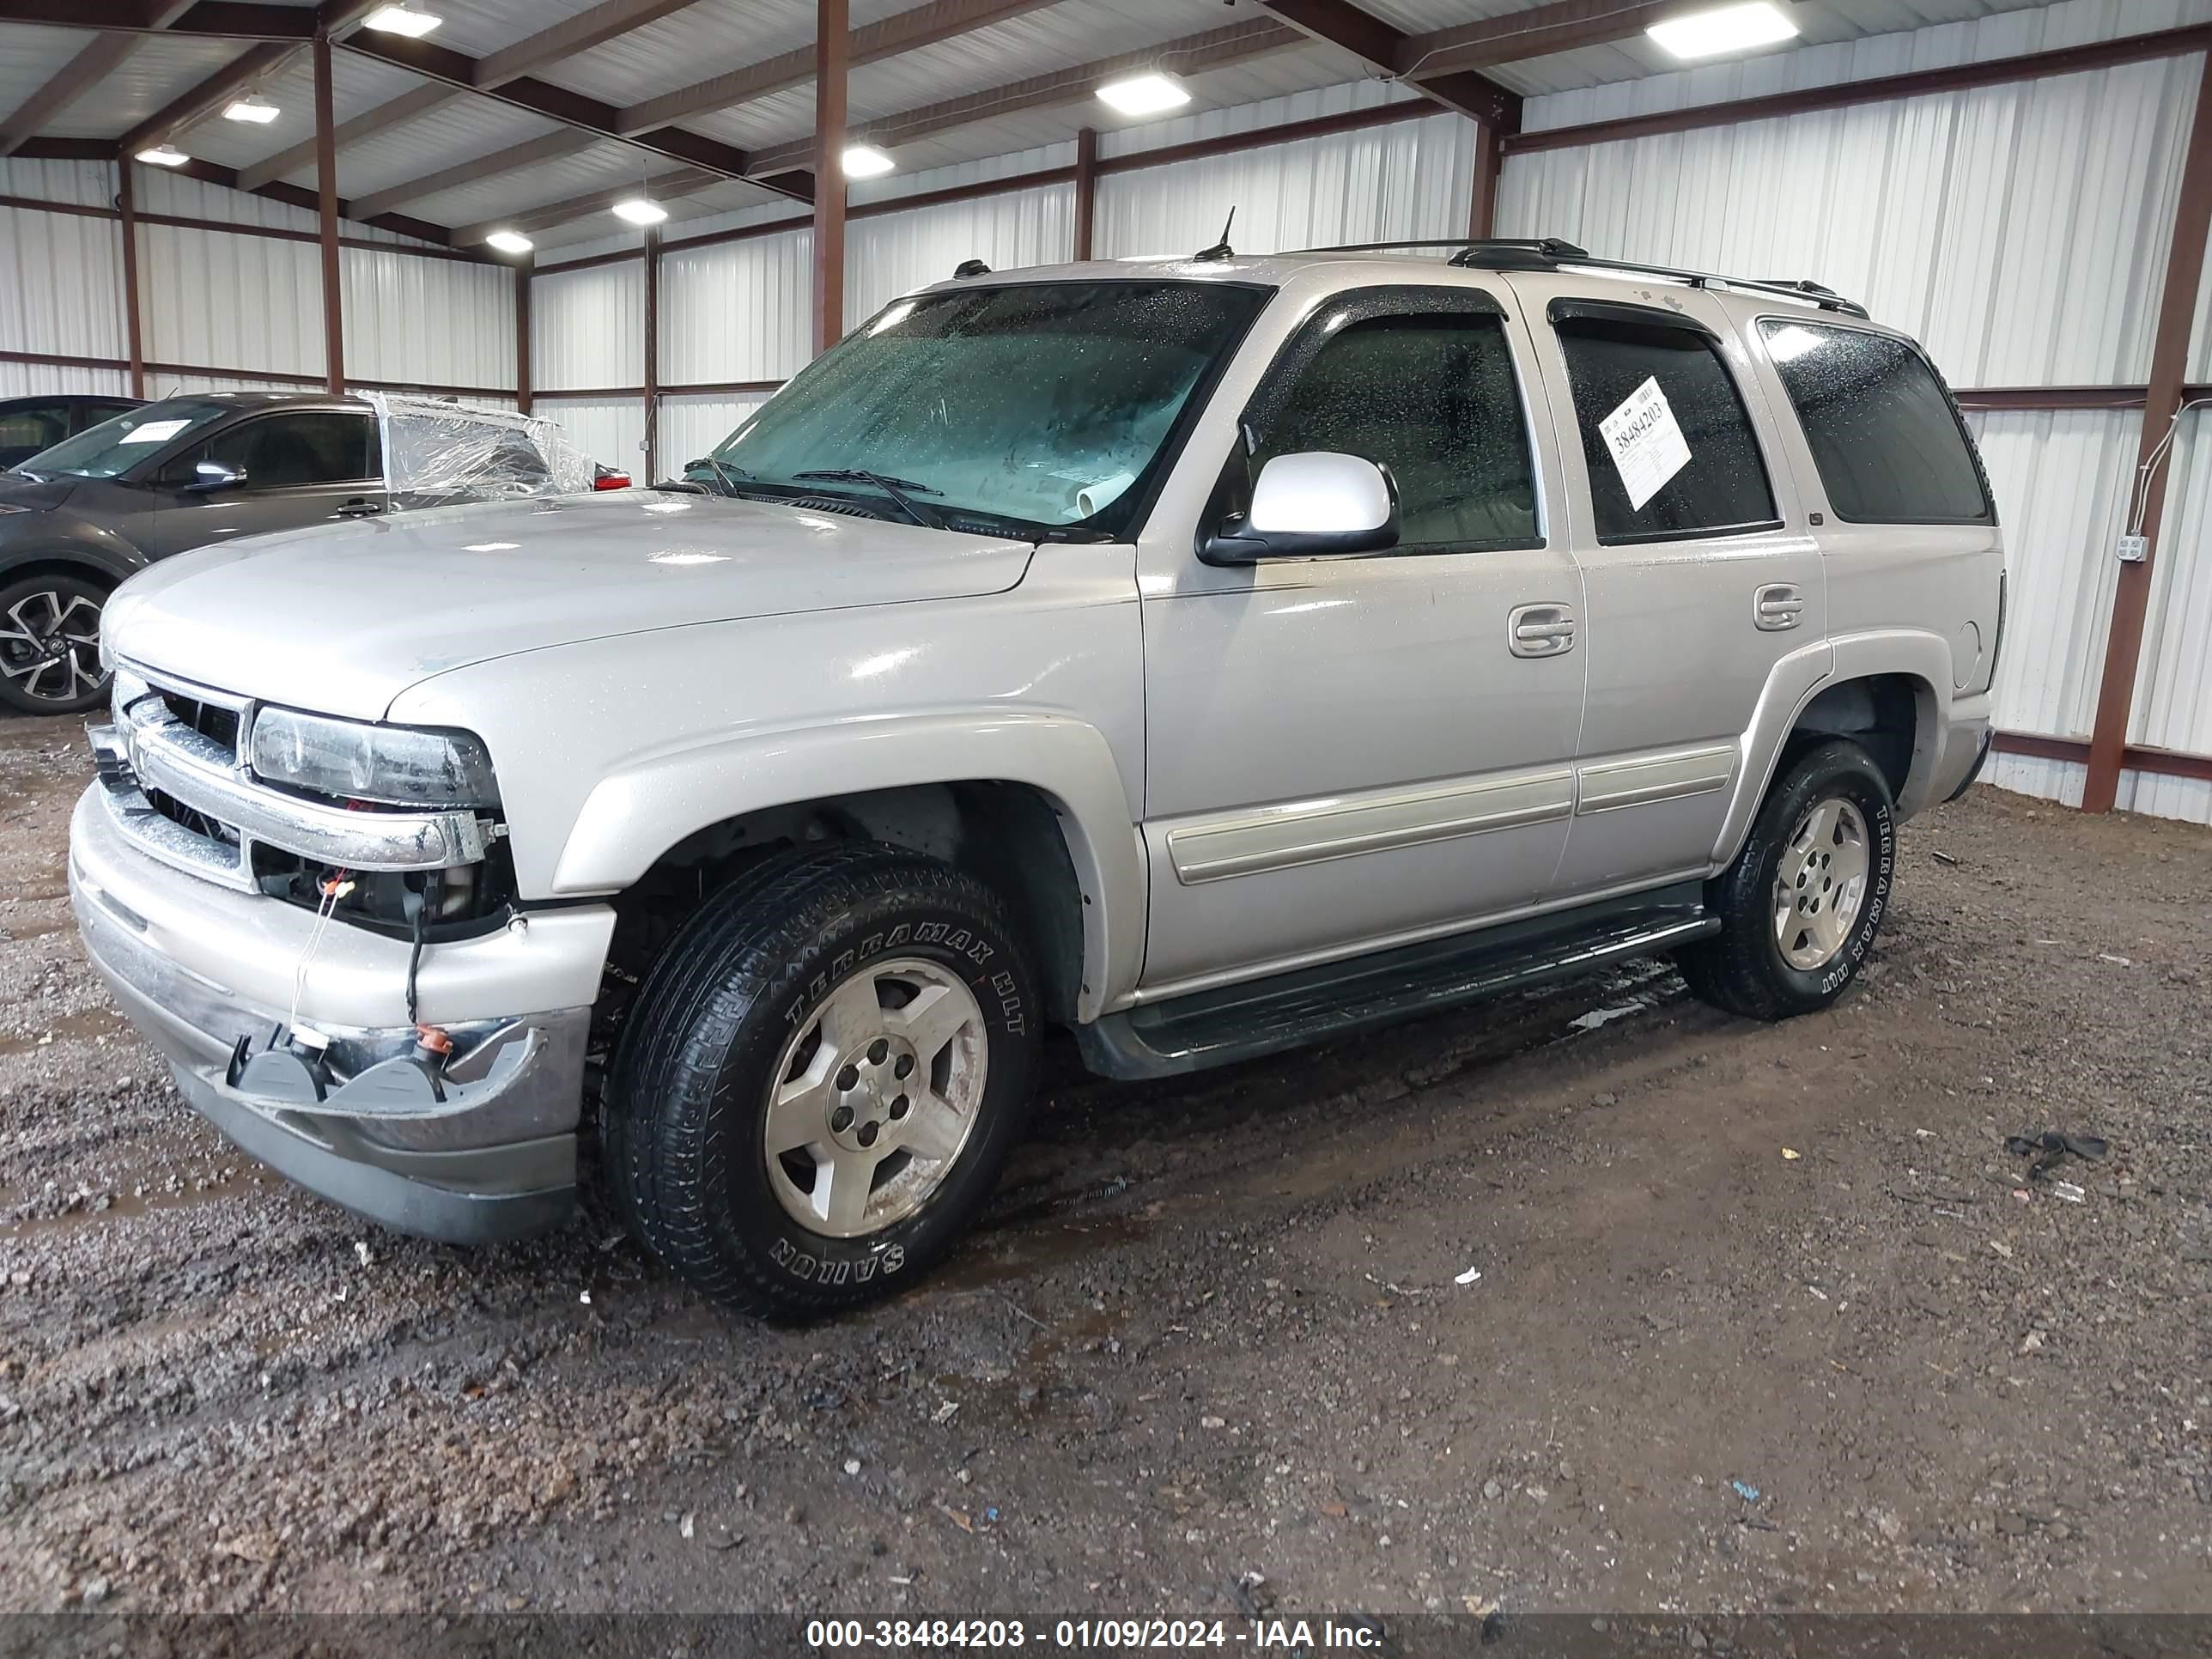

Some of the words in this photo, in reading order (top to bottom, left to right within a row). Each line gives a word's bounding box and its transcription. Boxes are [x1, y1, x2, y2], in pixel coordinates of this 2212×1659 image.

[1614, 402, 1662, 454] 38484203
[1851, 805, 1891, 963] TERRAMAX
[784, 922, 994, 1024] TERRAMAX
[990, 969, 1026, 1036] HLT
[769, 1237, 905, 1285] SAILUN
